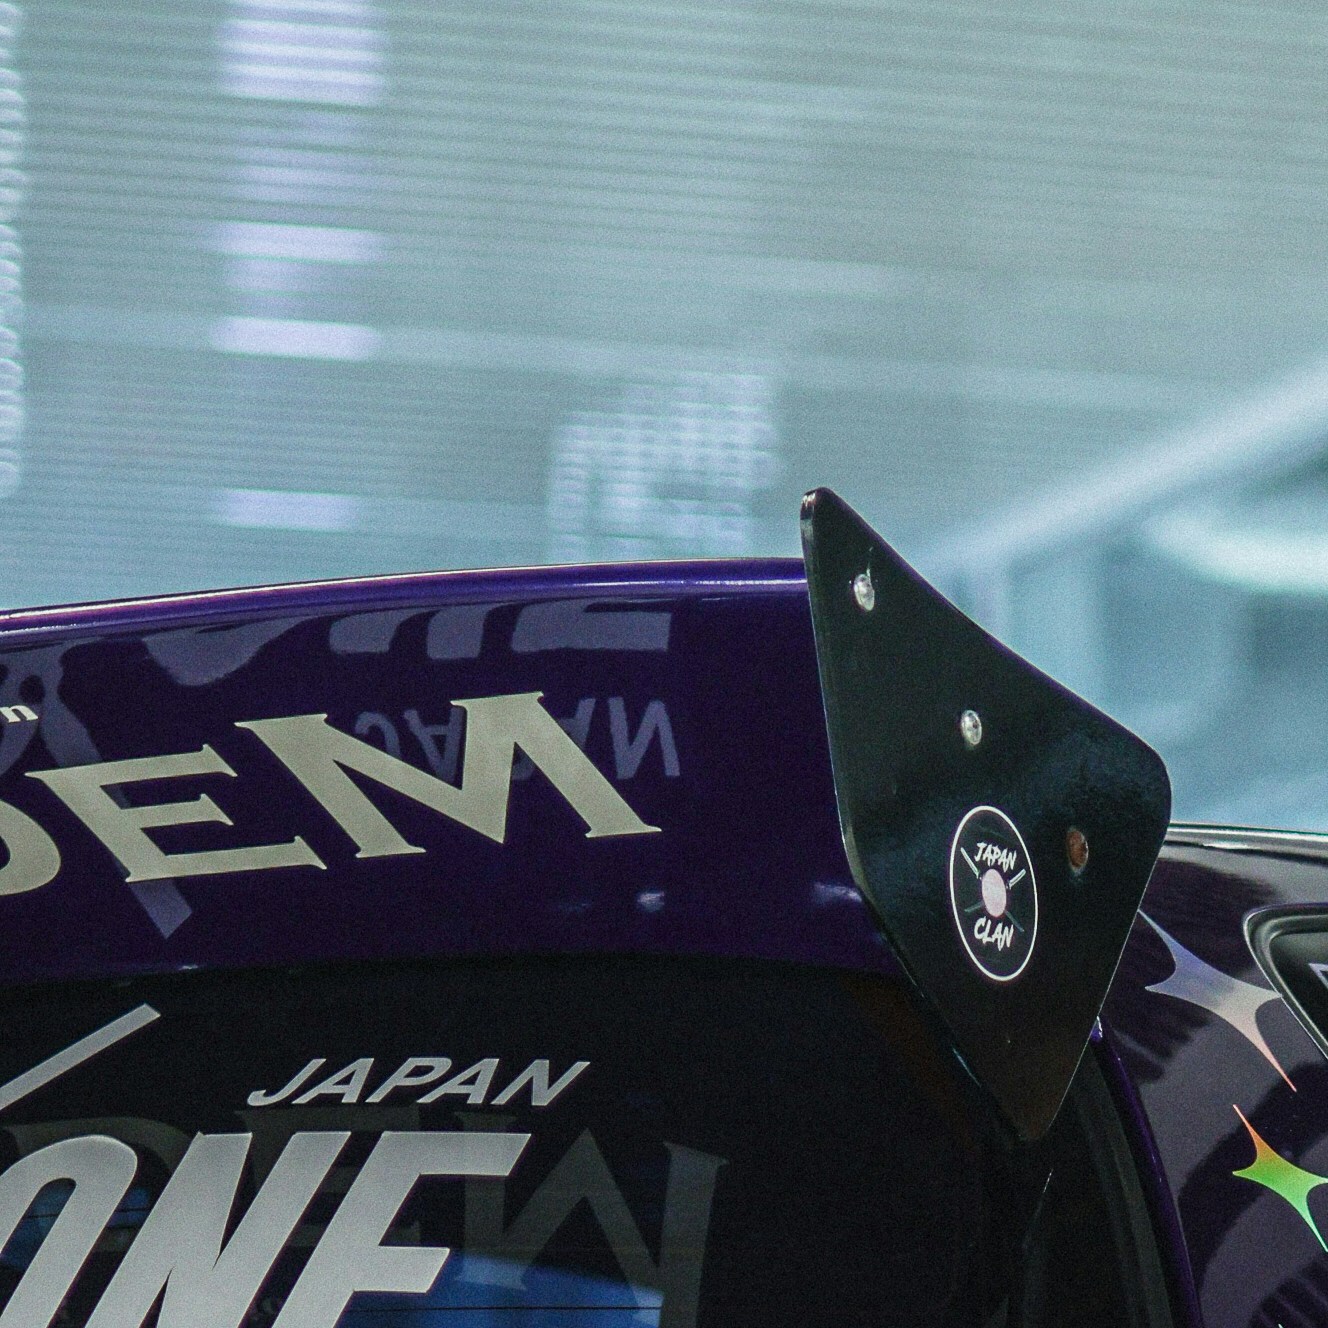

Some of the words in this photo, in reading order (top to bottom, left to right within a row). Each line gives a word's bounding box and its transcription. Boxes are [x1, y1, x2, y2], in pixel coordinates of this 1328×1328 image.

[975, 843, 1017, 872] JAPAN
[974, 917, 1013, 951] CLAN
[247, 1058, 590, 1106] JAPAN
